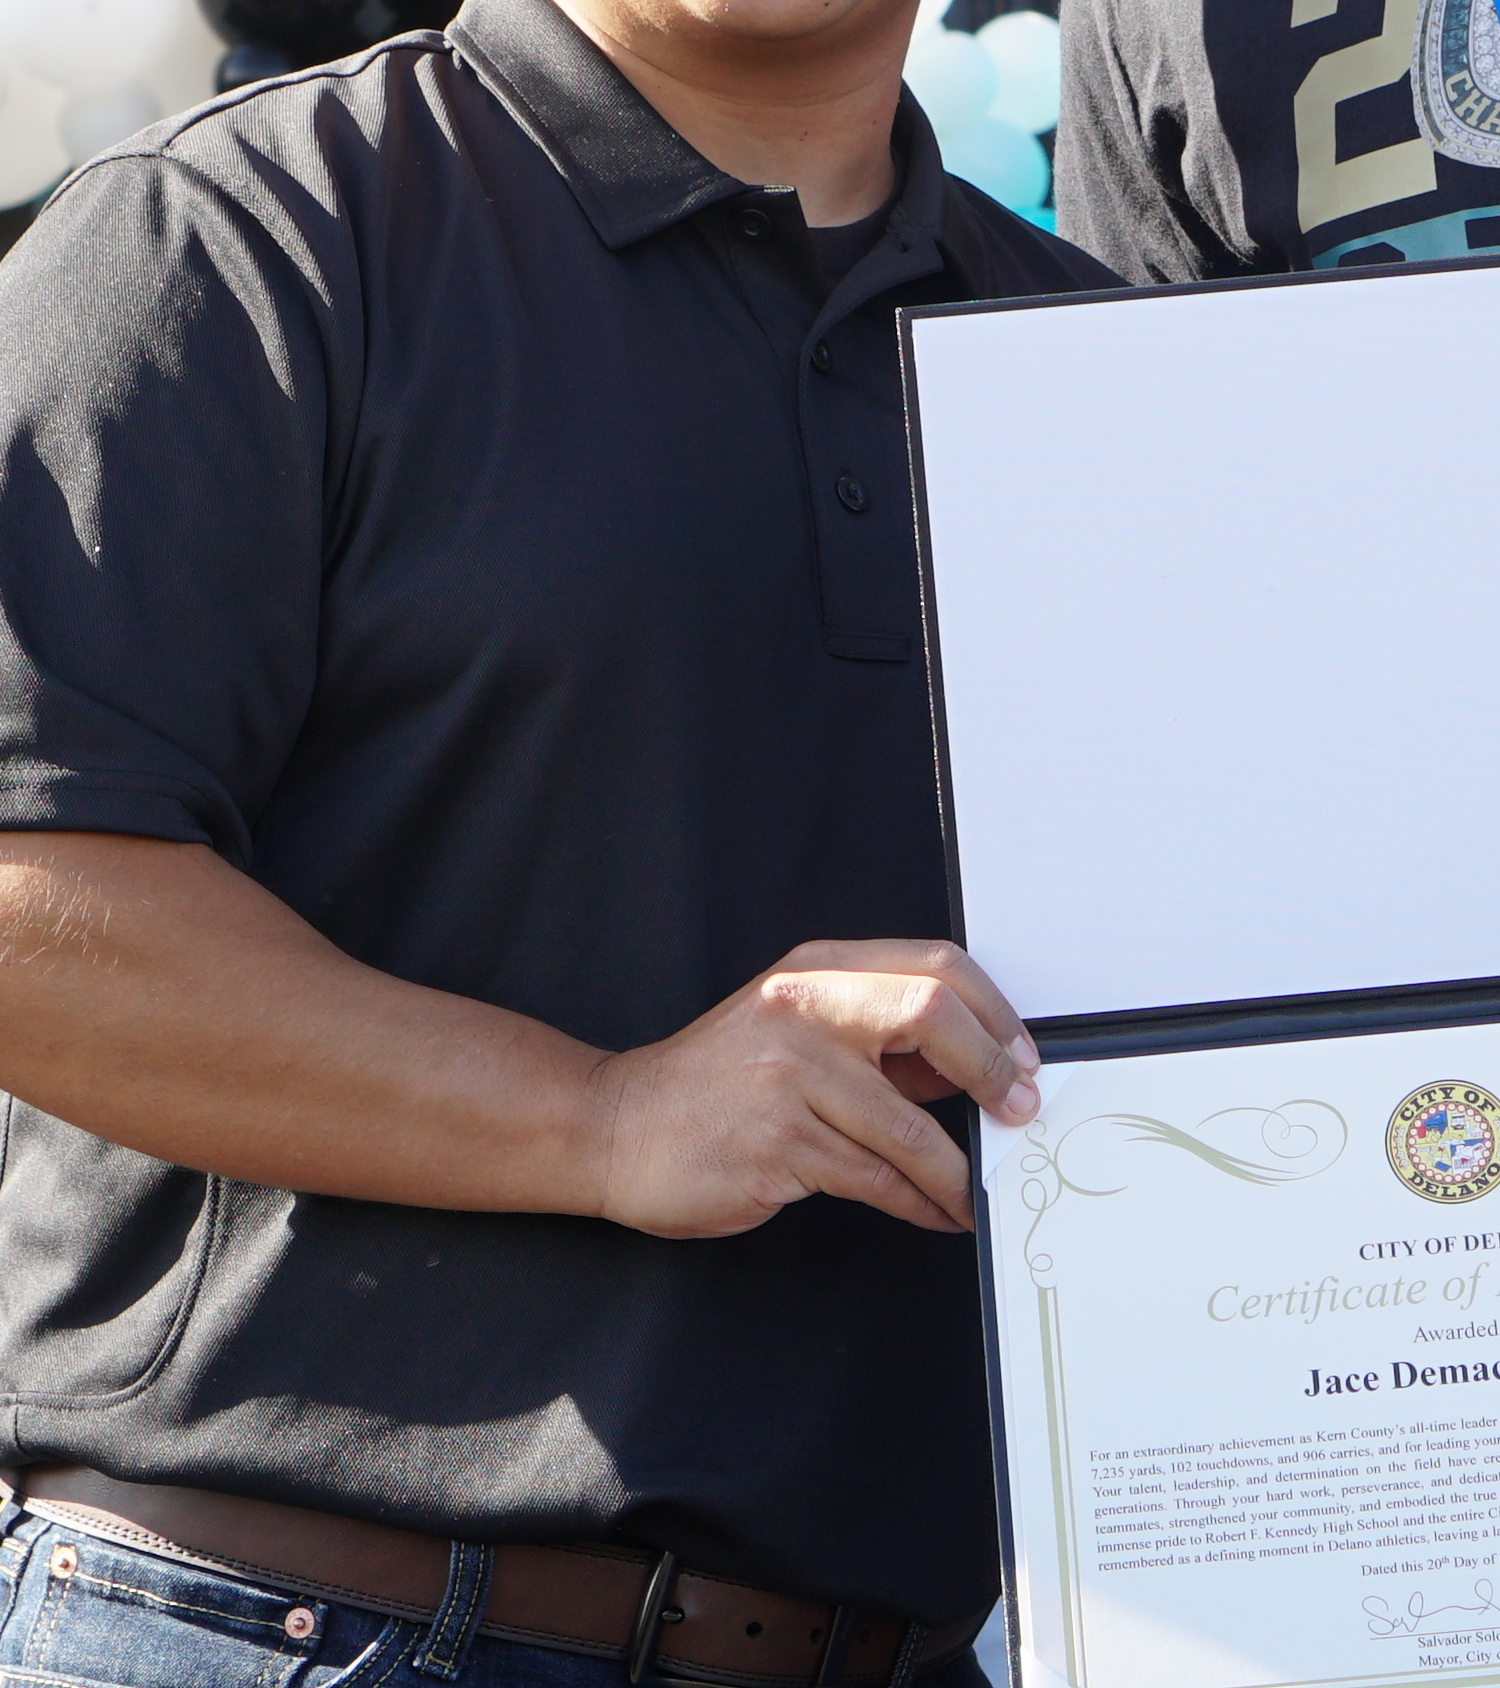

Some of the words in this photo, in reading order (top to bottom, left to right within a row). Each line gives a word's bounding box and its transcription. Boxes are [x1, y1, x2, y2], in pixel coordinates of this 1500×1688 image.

[1400, 1086, 1456, 1122] CITY
[1463, 1090, 1497, 1114] OF
[1358, 1239, 1418, 1261] CITY
[1423, 1236, 1458, 1255] OF
[1206, 1275, 1428, 1324] Certificate
[1440, 1263, 1486, 1312] of
[1412, 1319, 1499, 1343] Awarded
[1303, 1369, 1380, 1397] Jace
[1088, 1450, 1111, 1462] For
[1114, 1450, 1130, 1459] an
[1132, 1442, 1215, 1458] extraordinary
[1218, 1435, 1296, 1451] achievement
[1298, 1435, 1313, 1444] as
[1315, 1430, 1347, 1442] Kern
[1349, 1424, 1407, 1439] County’s
[1408, 1420, 1457, 1434] all-time
[1459, 1416, 1498, 1430] leader
[1091, 1486, 1123, 1498] Your
[1128, 1483, 1167, 1495] talent,
[1172, 1475, 1240, 1491] leadership,
[1245, 1472, 1269, 1485] and
[1273, 1465, 1360, 1483] determination
[1364, 1465, 1382, 1474] on
[1387, 1461, 1407, 1472] the
[1413, 1457, 1442, 1470] field
[1446, 1456, 1477, 1467] have
[1093, 1501, 1168, 1519] generations.
[1172, 1494, 1226, 1510] Through
[1231, 1494, 1261, 1508] your
[1265, 1488, 1294, 1502] hard
[1298, 1485, 1336, 1498] work,
[1339, 1480, 1425, 1498] perseverance,
[1429, 1474, 1453, 1487] and
[1094, 1521, 1165, 1535] teammates,
[1167, 1511, 1247, 1529] strengthened
[1249, 1511, 1279, 1524] your
[1281, 1502, 1355, 1519] community,
[1358, 1498, 1382, 1512] and
[1384, 1493, 1446, 1509] embodied
[1449, 1492, 1469, 1504] the
[1472, 1492, 1498, 1501] true
[1097, 1553, 1175, 1571] remembered
[1177, 1555, 1192, 1565] as
[1193, 1554, 1202, 1563] a
[1203, 1548, 1257, 1562] defining
[1258, 1544, 1310, 1558] moment
[1311, 1541, 1325, 1553] in
[1327, 1538, 1373, 1551] Delano
[1374, 1533, 1431, 1547] athletics,
[1432, 1528, 1479, 1542] leaving
[1481, 1529, 1490, 1538] a
[1361, 1562, 1399, 1576] Dated
[1400, 1560, 1424, 1572] this
[1427, 1556, 1451, 1571] 20th
[1453, 1556, 1479, 1569] Day
[1482, 1553, 1497, 1565] of
[1417, 1634, 1473, 1649] Salvador
[1418, 1654, 1463, 1669] Mayor,
[1465, 1650, 1492, 1665] City
